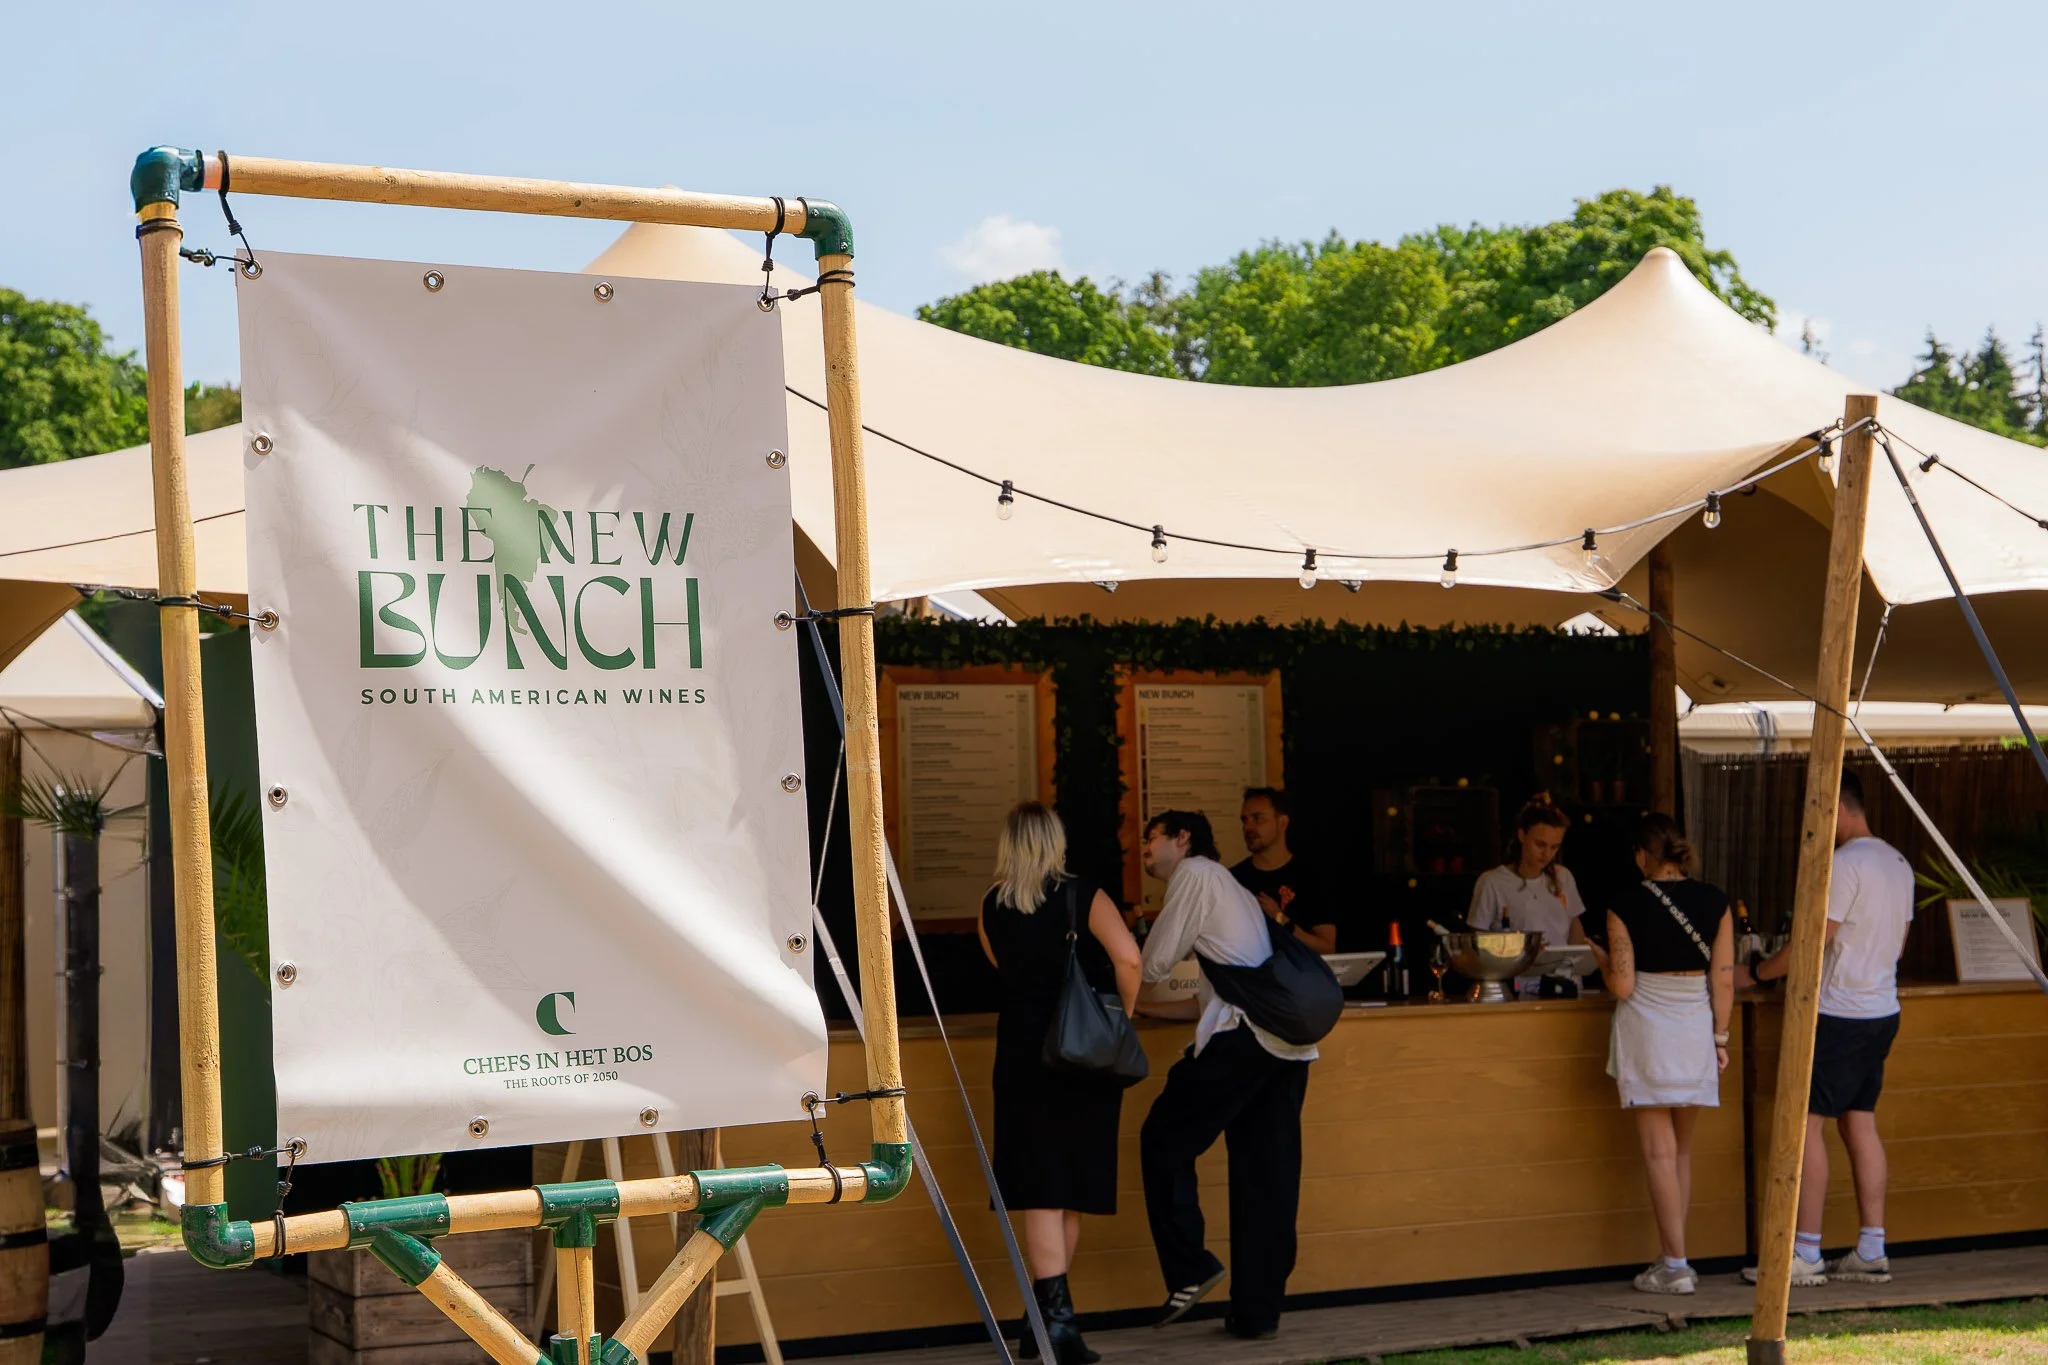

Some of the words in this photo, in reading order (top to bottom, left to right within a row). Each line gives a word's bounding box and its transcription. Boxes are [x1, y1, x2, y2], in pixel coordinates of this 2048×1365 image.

[353, 503, 496, 563] THE
[537, 506, 695, 566] NEW
[357, 569, 704, 671] BUNCH
[361, 688, 457, 705] SOUTH
[471, 688, 608, 705] AMERICAN
[623, 687, 706, 704] WINES
[899, 690, 922, 701] NEW
[924, 690, 959, 701] BUNCH
[1139, 690, 1160, 700] NEW
[1161, 690, 1195, 700] BUNCH
[463, 1054, 531, 1075] CHEFS
[536, 1051, 559, 1070] IN
[565, 1047, 607, 1067] HET
[612, 1044, 653, 1064] BOS
[503, 1078, 529, 1090] THE
[531, 1074, 571, 1087] ROOTS
[574, 1073, 590, 1083] OF
[593, 1070, 619, 1082] 2050
